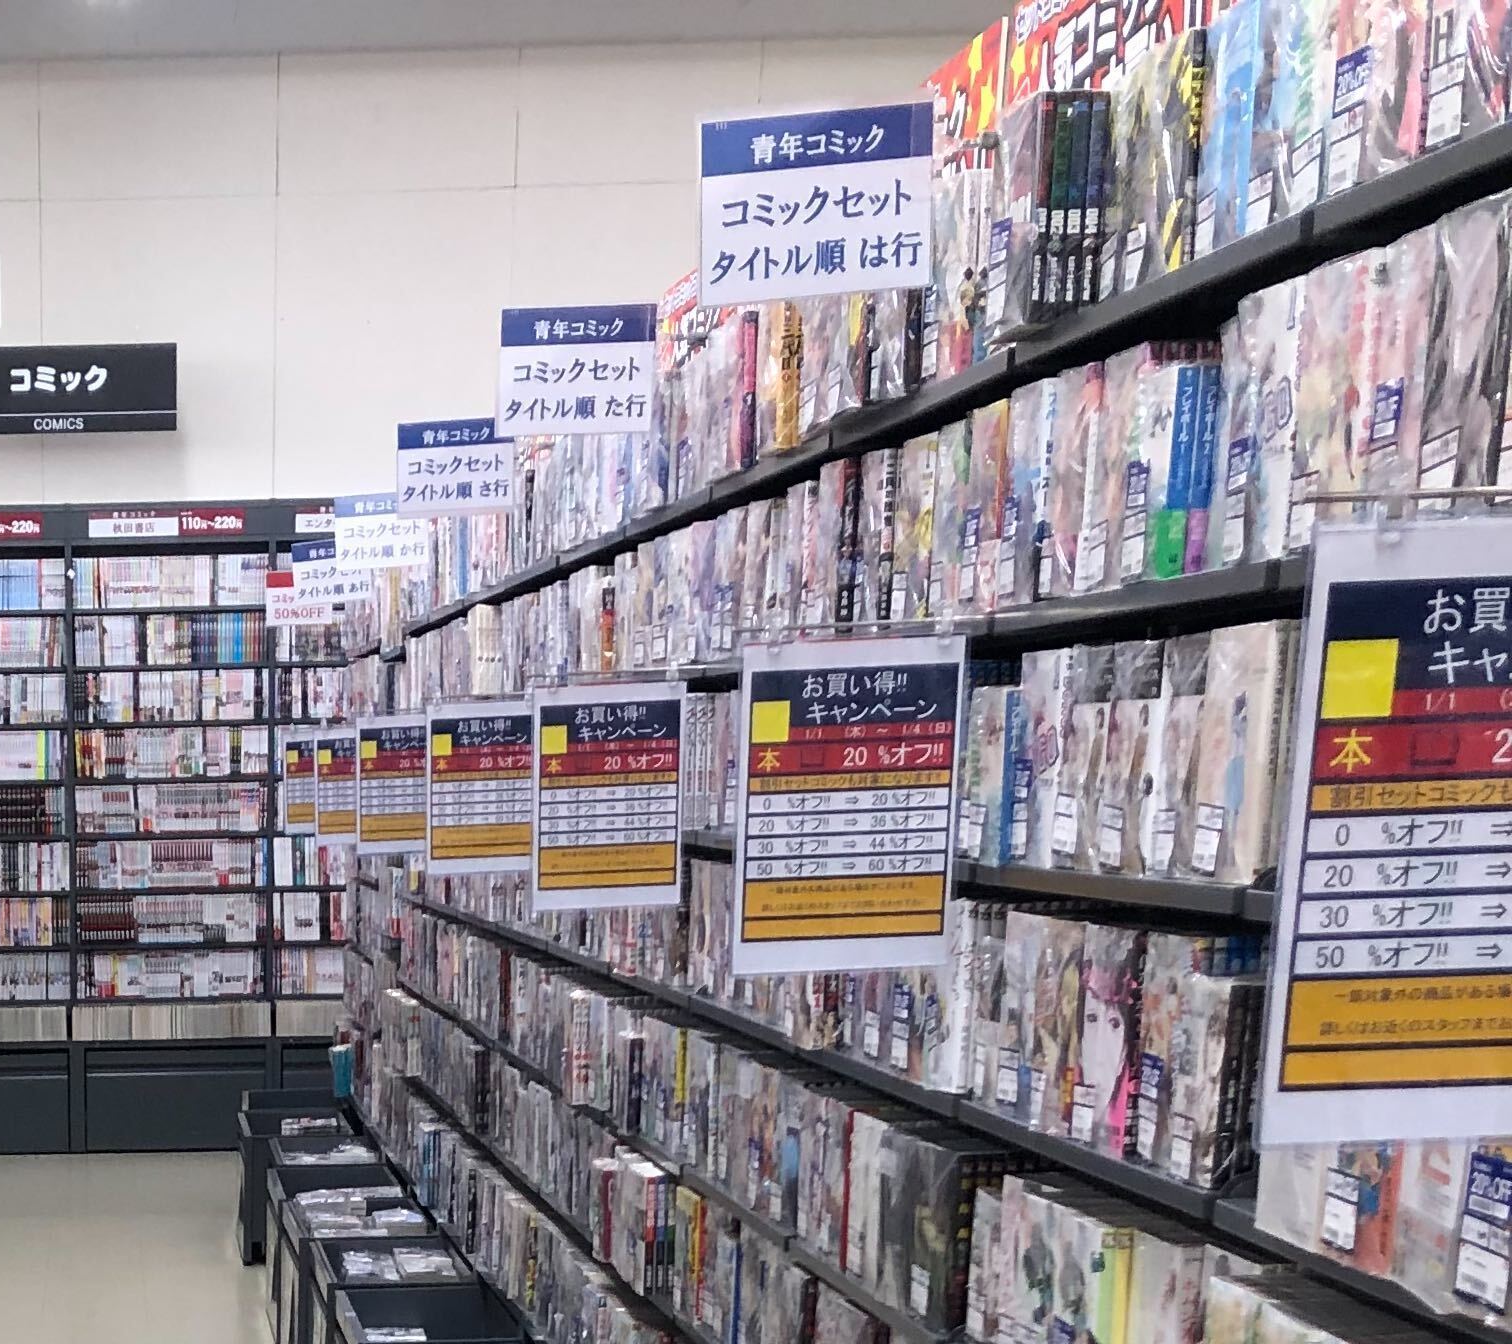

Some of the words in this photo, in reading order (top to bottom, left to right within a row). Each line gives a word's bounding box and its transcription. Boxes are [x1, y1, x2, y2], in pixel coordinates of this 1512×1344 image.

[750, 123, 885, 165] 青年コミック
[722, 178, 911, 228] コミックセット
[710, 237, 846, 285] タイトル順
[860, 231, 922, 269] は行
[533, 317, 624, 340] 青年コミック
[10, 364, 108, 392] コミック
[513, 356, 640, 383] コミックセット
[504, 396, 596, 421] タイトル順
[605, 394, 646, 418] た行
[33, 418, 84, 431] COMICS
[422, 427, 490, 445] 青年コミック
[408, 453, 504, 475] コミックセット
[402, 480, 473, 503] タイトル順
[479, 478, 509, 497] さ行
[344, 519, 420, 539] コミックセット
[274, 607, 325, 619] 50%OFF
[1428, 640, 1512, 684] キャ
[801, 670, 908, 699] お買い得!!
[806, 698, 937, 725] キャンペーン
[1424, 692, 1457, 711] 1/1
[459, 732, 527, 746] キャンペーン
[578, 723, 667, 742] キャンペーン
[757, 747, 781, 773] 本
[841, 747, 868, 767] 20
[1329, 728, 1373, 773] 本
[479, 757, 492, 769] 20
[546, 757, 562, 773] 本
[604, 756, 621, 770] 20
[758, 819, 774, 833] 20
[1335, 824, 1350, 846] 0
[757, 841, 773, 854] 30
[1324, 864, 1354, 888] 20
[1320, 905, 1350, 929] 30
[1315, 945, 1345, 969] 50
